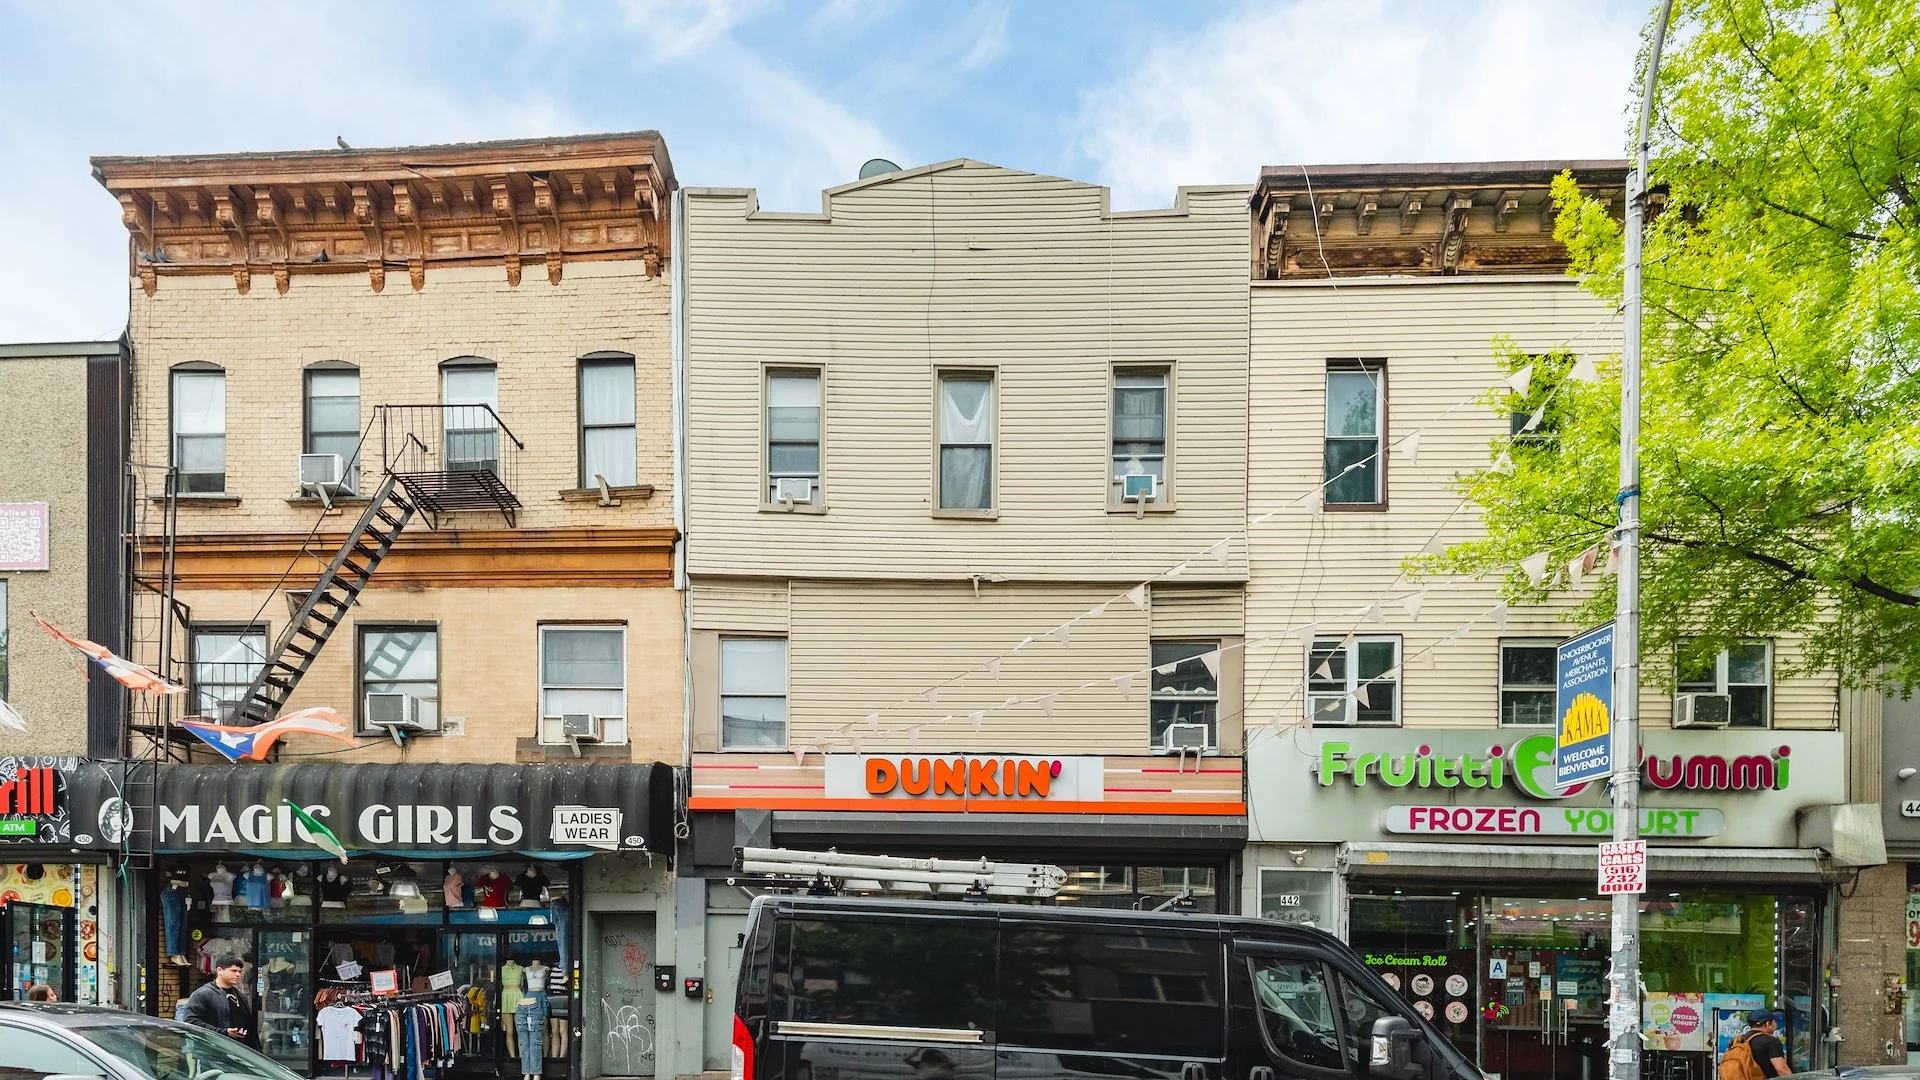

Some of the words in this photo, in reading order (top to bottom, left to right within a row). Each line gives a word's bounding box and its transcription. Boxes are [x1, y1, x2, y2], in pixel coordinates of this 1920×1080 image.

[1560, 634, 1612, 662] KNICKERBOCKER
[1572, 650, 1598, 666] AVENUE
[1565, 657, 1606, 679] MERCHANTS
[1563, 666, 1608, 690] ASSOCIATION
[1566, 707, 1603, 743] KAMA
[1563, 744, 1605, 764] WELCOME
[1320, 742, 1504, 788] Fruitti
[1638, 744, 1792, 790] ummi
[1559, 755, 1609, 777] BIENVENIDO
[866, 758, 1062, 797] DUNKIN'
[158, 804, 331, 844] MAGIC
[358, 804, 523, 845] GIRLS
[560, 813, 612, 825] LADIES
[1409, 807, 1540, 832] FROZEN
[1565, 809, 1700, 834] YOURT
[2, 824, 25, 832] ATM
[565, 828, 609, 839] WEAR
[627, 837, 642, 845] 450
[1601, 854, 1643, 866] CARS
[1604, 865, 1641, 875] (516)
[1605, 875, 1638, 883] 232
[1600, 883, 1644, 892] 0007
[1281, 895, 1299, 905] 442
[1365, 954, 1384, 966] Ice
[1384, 955, 1421, 966] Cream
[1422, 955, 1448, 967] Roll
[1492, 961, 1503, 973] A
[1673, 1013, 1697, 1021] FROZEN
